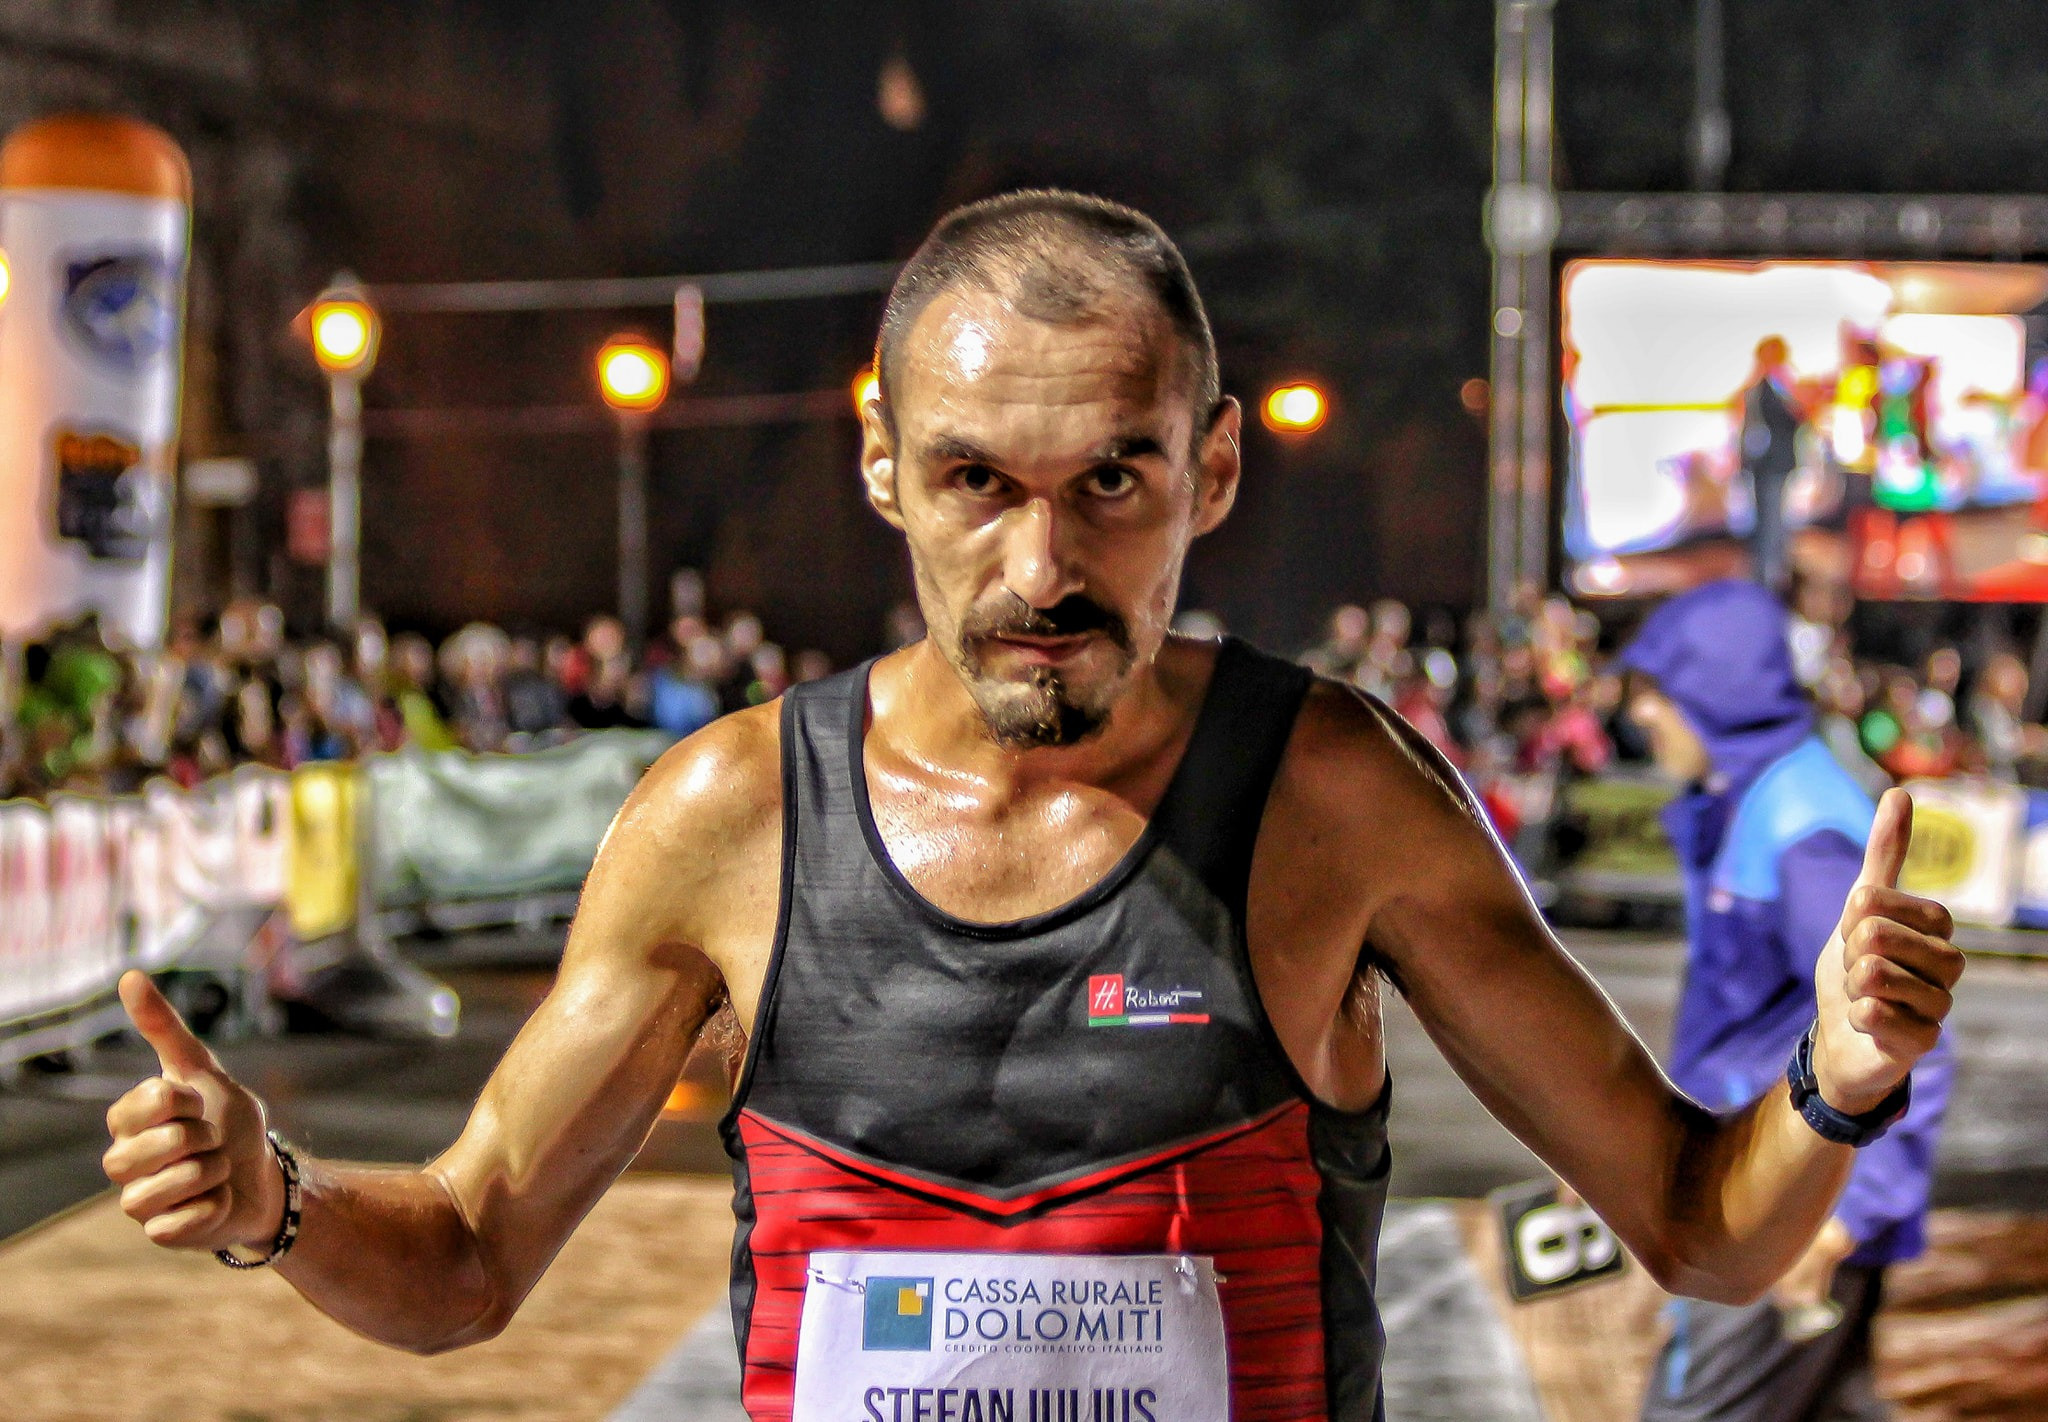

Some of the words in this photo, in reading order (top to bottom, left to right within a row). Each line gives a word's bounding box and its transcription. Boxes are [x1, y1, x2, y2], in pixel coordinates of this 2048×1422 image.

[944, 1278, 1041, 1304] CASSA
[1052, 1279, 1163, 1305] RURALE
[945, 1309, 1163, 1341] DOLOMITI
[944, 1344, 999, 1353] CREDITO
[1004, 1344, 1096, 1354] COOPERATIVO
[1101, 1345, 1164, 1354] ITALIANO
[862, 1386, 1014, 1422] STEFAN
